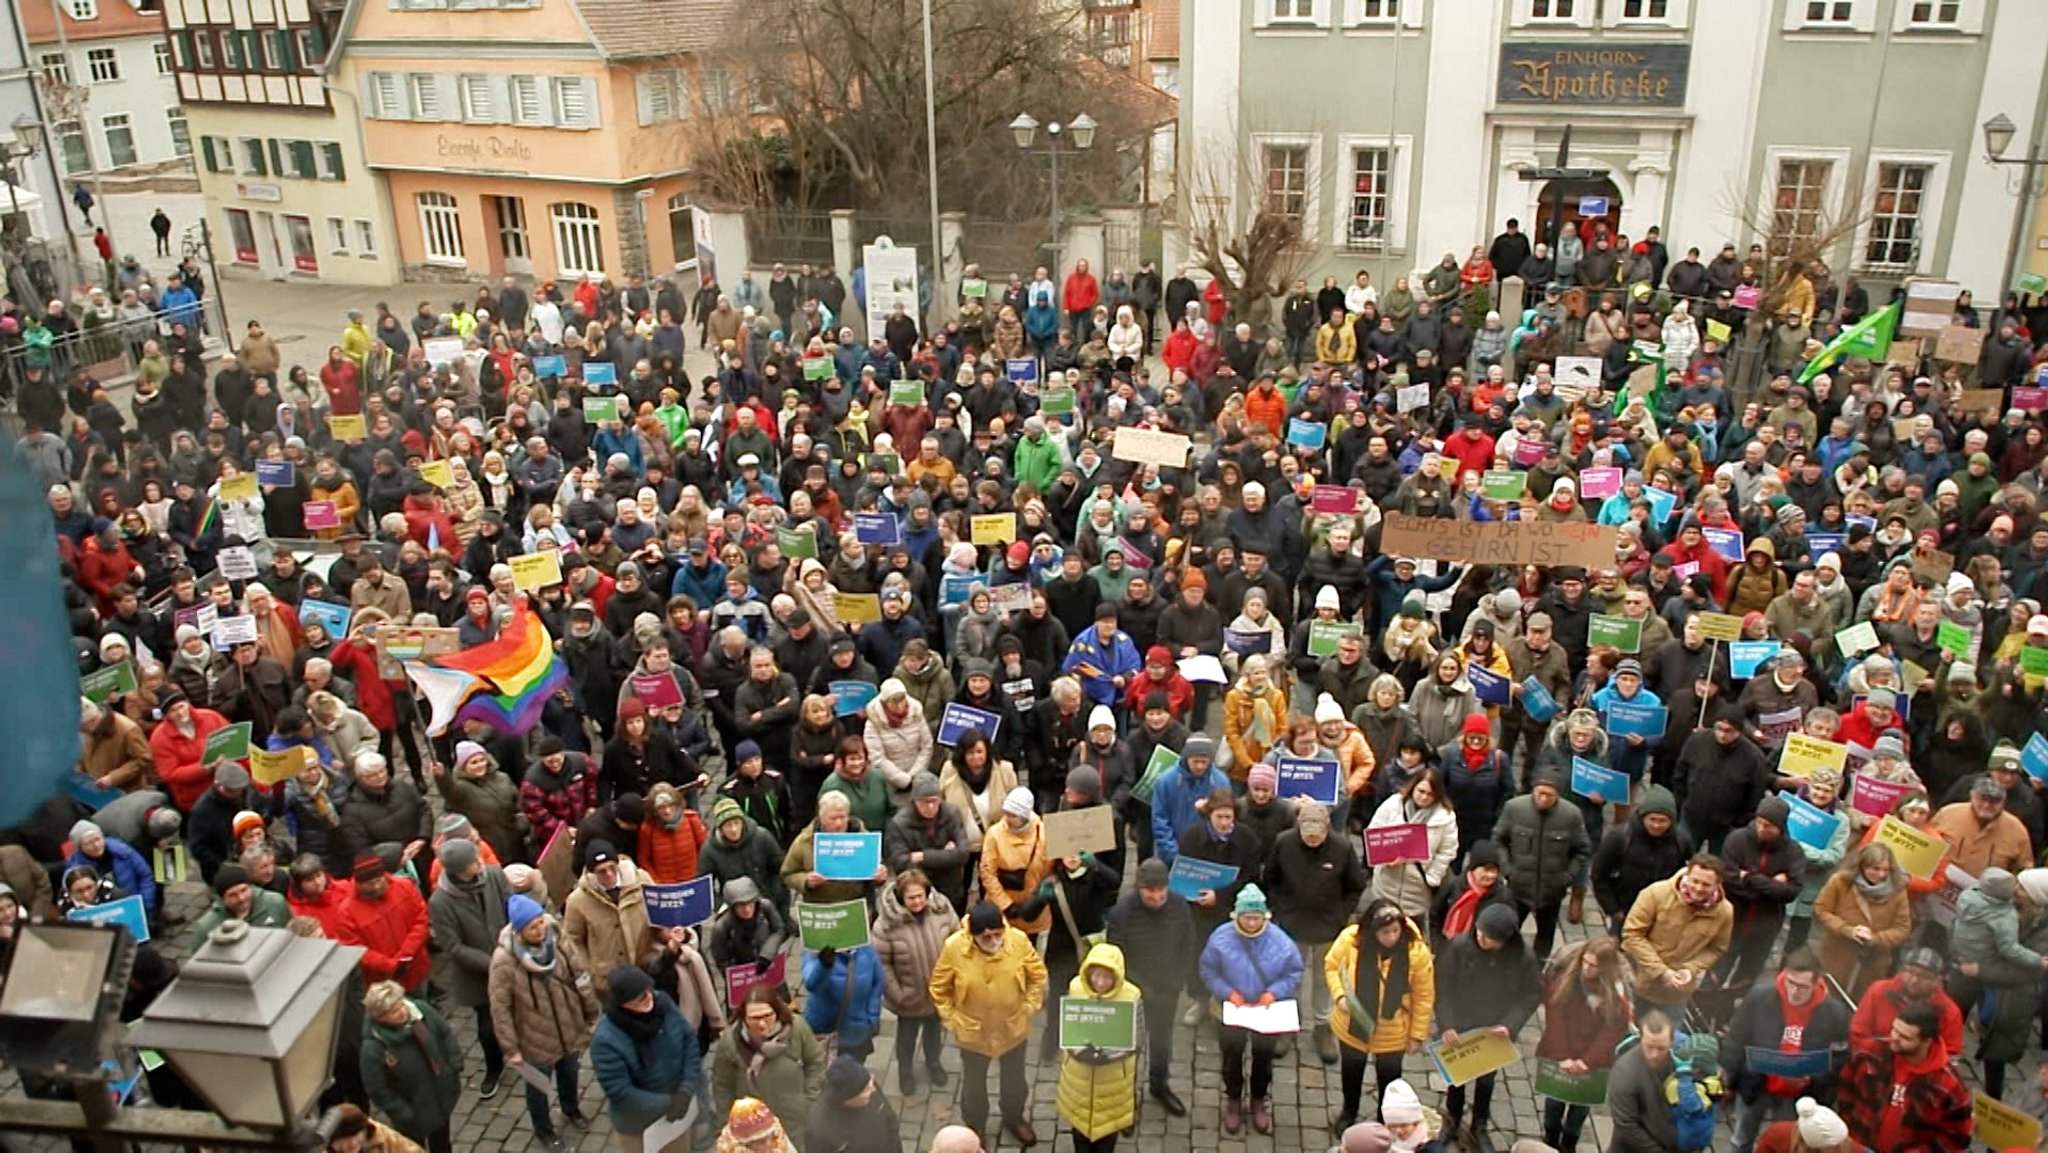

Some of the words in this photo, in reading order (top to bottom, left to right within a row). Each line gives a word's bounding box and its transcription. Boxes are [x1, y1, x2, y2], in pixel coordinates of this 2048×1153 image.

[1555, 51, 1645, 65] EINHORN-
[1512, 59, 1670, 101] Apotheke
[1384, 515, 1449, 536] RECHTS
[1459, 522, 1482, 538] IST
[1499, 522, 1520, 539] DA
[1426, 538, 1518, 562] GEHIRN
[1529, 542, 1569, 564] IST
